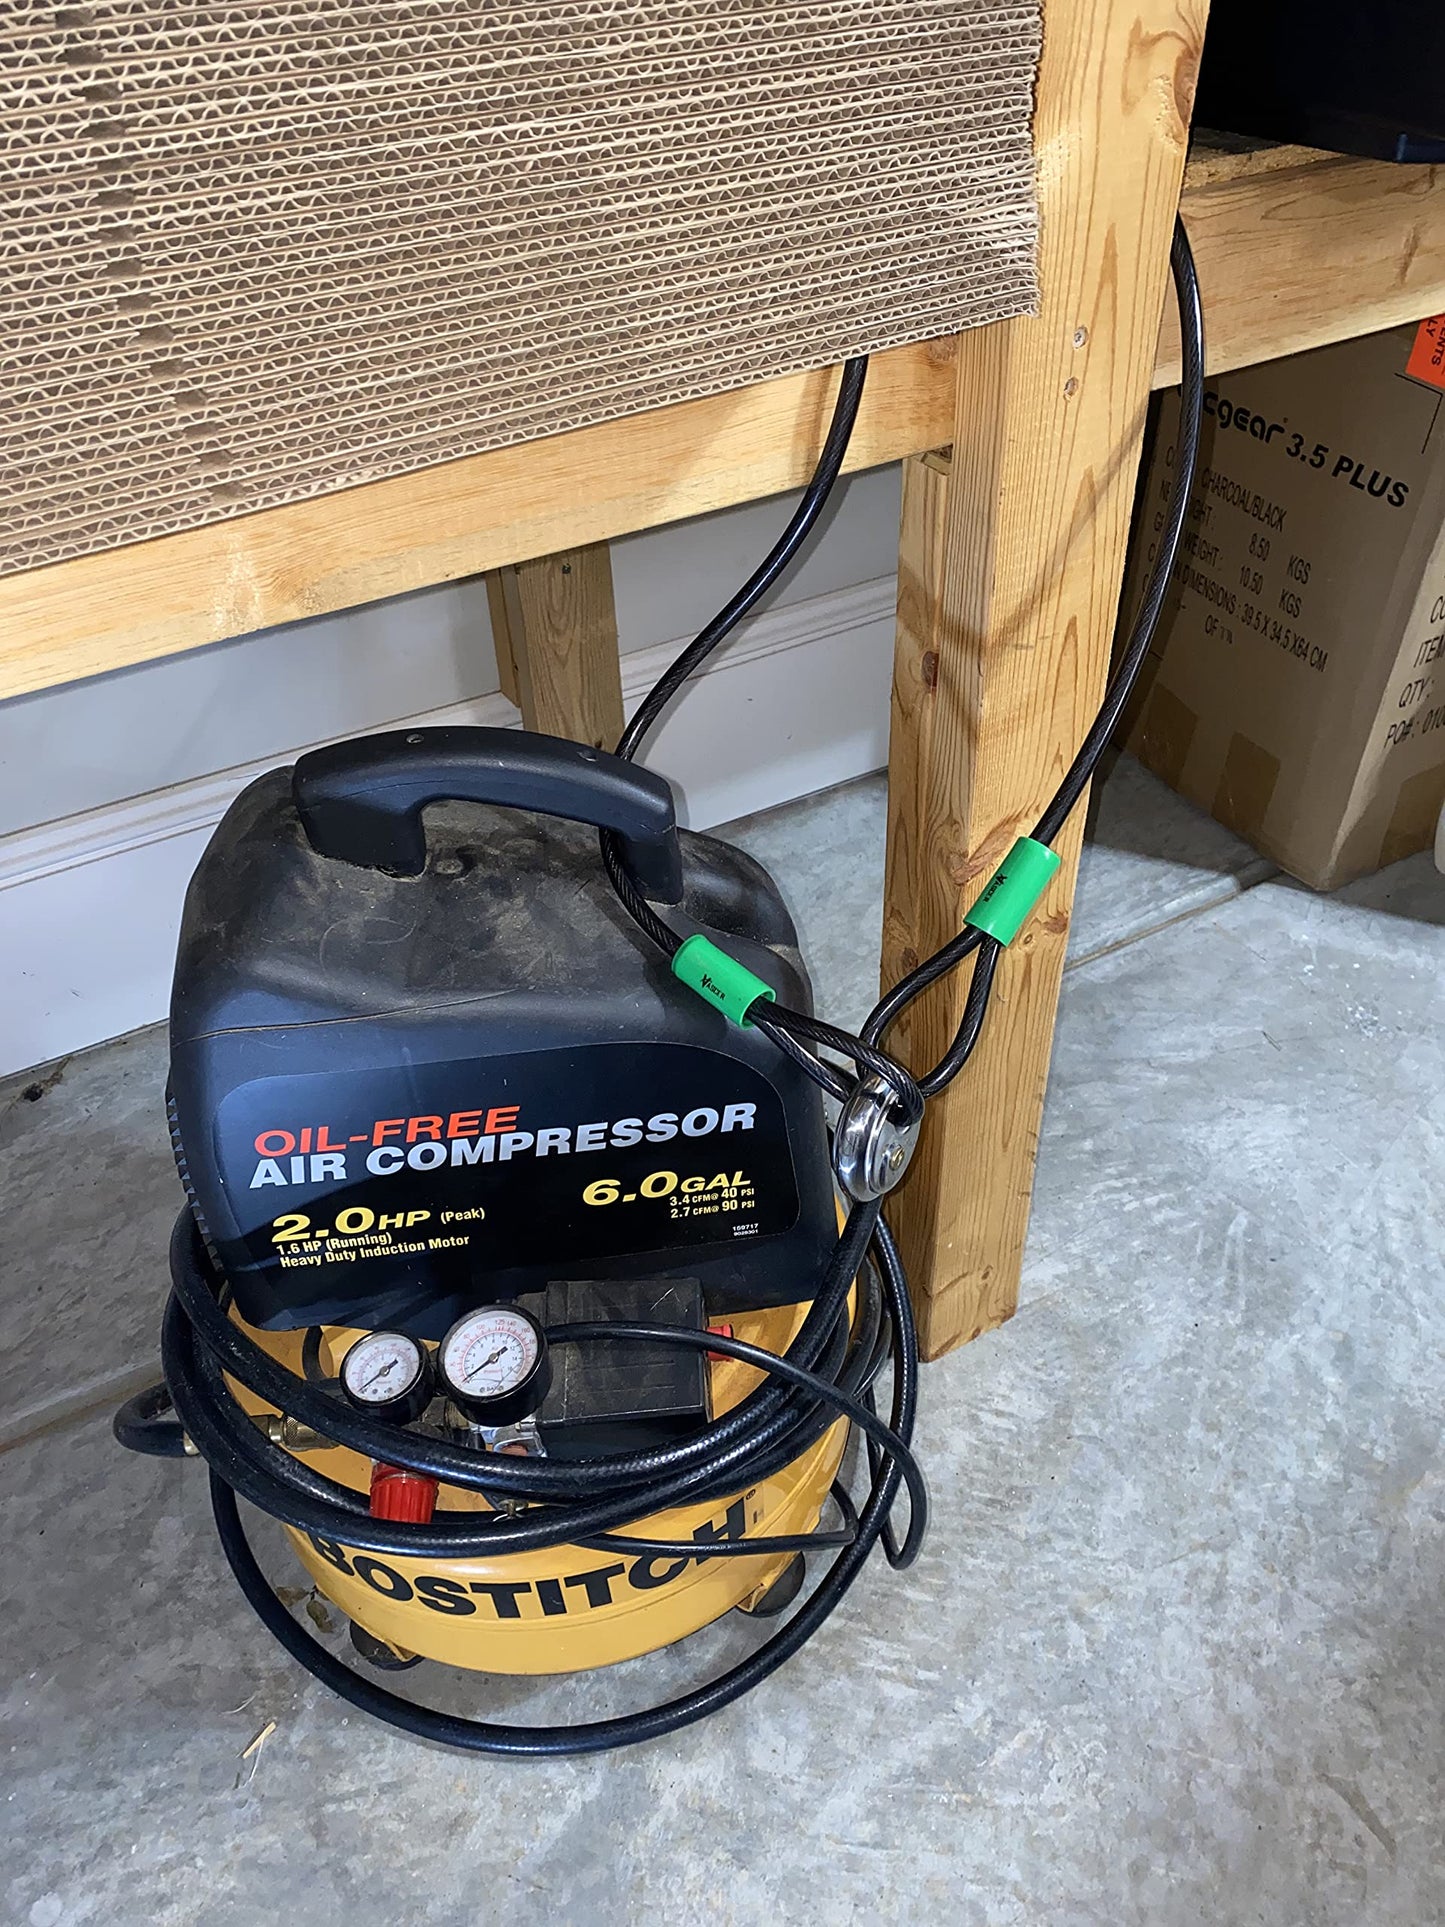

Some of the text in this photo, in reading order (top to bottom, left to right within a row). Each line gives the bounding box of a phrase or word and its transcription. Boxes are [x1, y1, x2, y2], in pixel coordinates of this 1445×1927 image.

[1286, 433, 1330, 468] 3.5
[1331, 455, 1409, 507] PLUS
[1287, 555, 1311, 584] KGS
[1239, 566, 1263, 595] 10.50
[1279, 589, 1302, 618] KGS
[1309, 646, 1328, 672] CM
[249, 1102, 757, 1189] AIR COMPRESSOR
[254, 1105, 521, 1158] OIL-FREE
[669, 1194, 690, 1206] 3.4
[721, 1187, 737, 1199] 40
[741, 1187, 755, 1197] PSI
[670, 1206, 690, 1219] 2.7
[721, 1199, 738, 1212] 90
[741, 1200, 755, 1209] PSI
[440, 1207, 485, 1224] (Peak)
[276, 1231, 393, 1256] 1.6 HP (Running)
[280, 1236, 469, 1268] Heavy Duty Induction Motor
[307, 1495, 746, 1619] BOSTITCH
